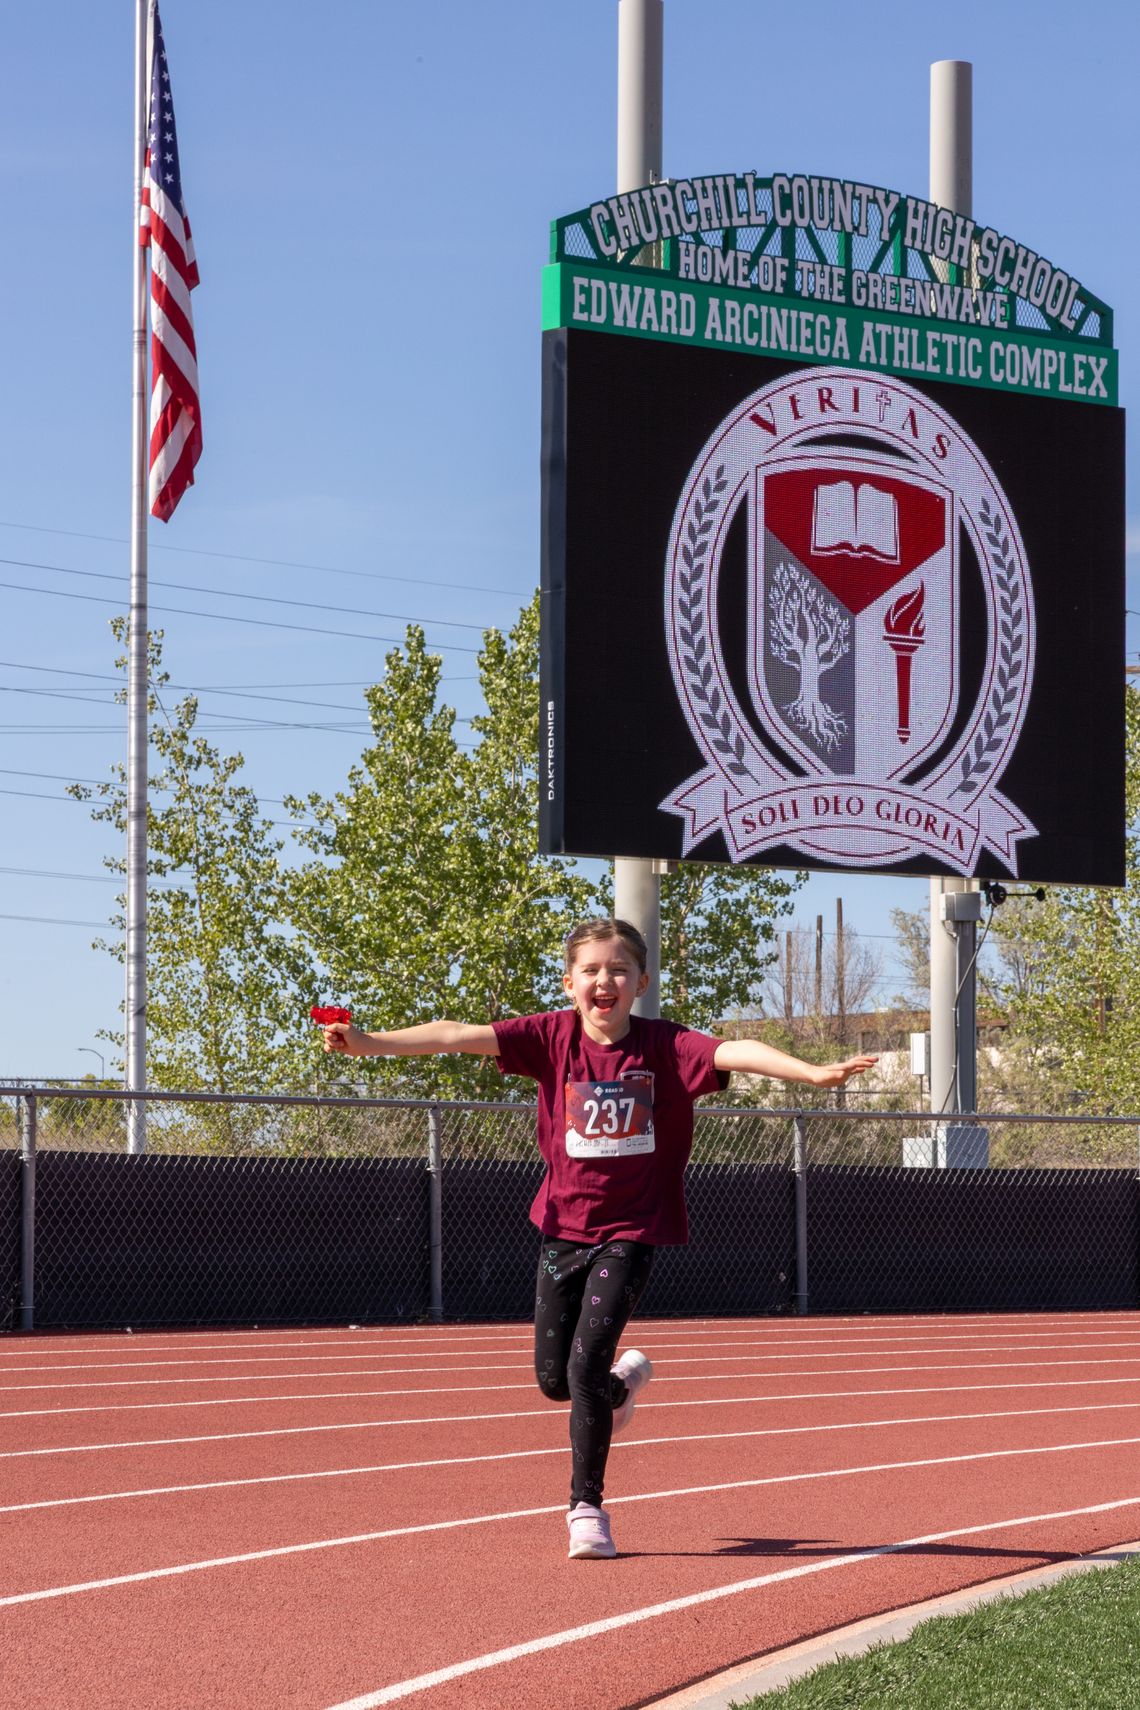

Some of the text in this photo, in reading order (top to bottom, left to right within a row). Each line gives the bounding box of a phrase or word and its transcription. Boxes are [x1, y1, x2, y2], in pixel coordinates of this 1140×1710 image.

[590, 174, 1082, 331] CHURCHILL COUNTY HIGH SCHOOL
[678, 242, 1008, 329] HOME OF THE GREENWAVE
[572, 276, 1108, 399] EDWARD ARCINIEGA ATHLETIC COMPLEX
[547, 701, 555, 801] DAKTRONICS
[741, 796, 965, 851] SOLI DEO GLORIA
[583, 1097, 635, 1135] 237
